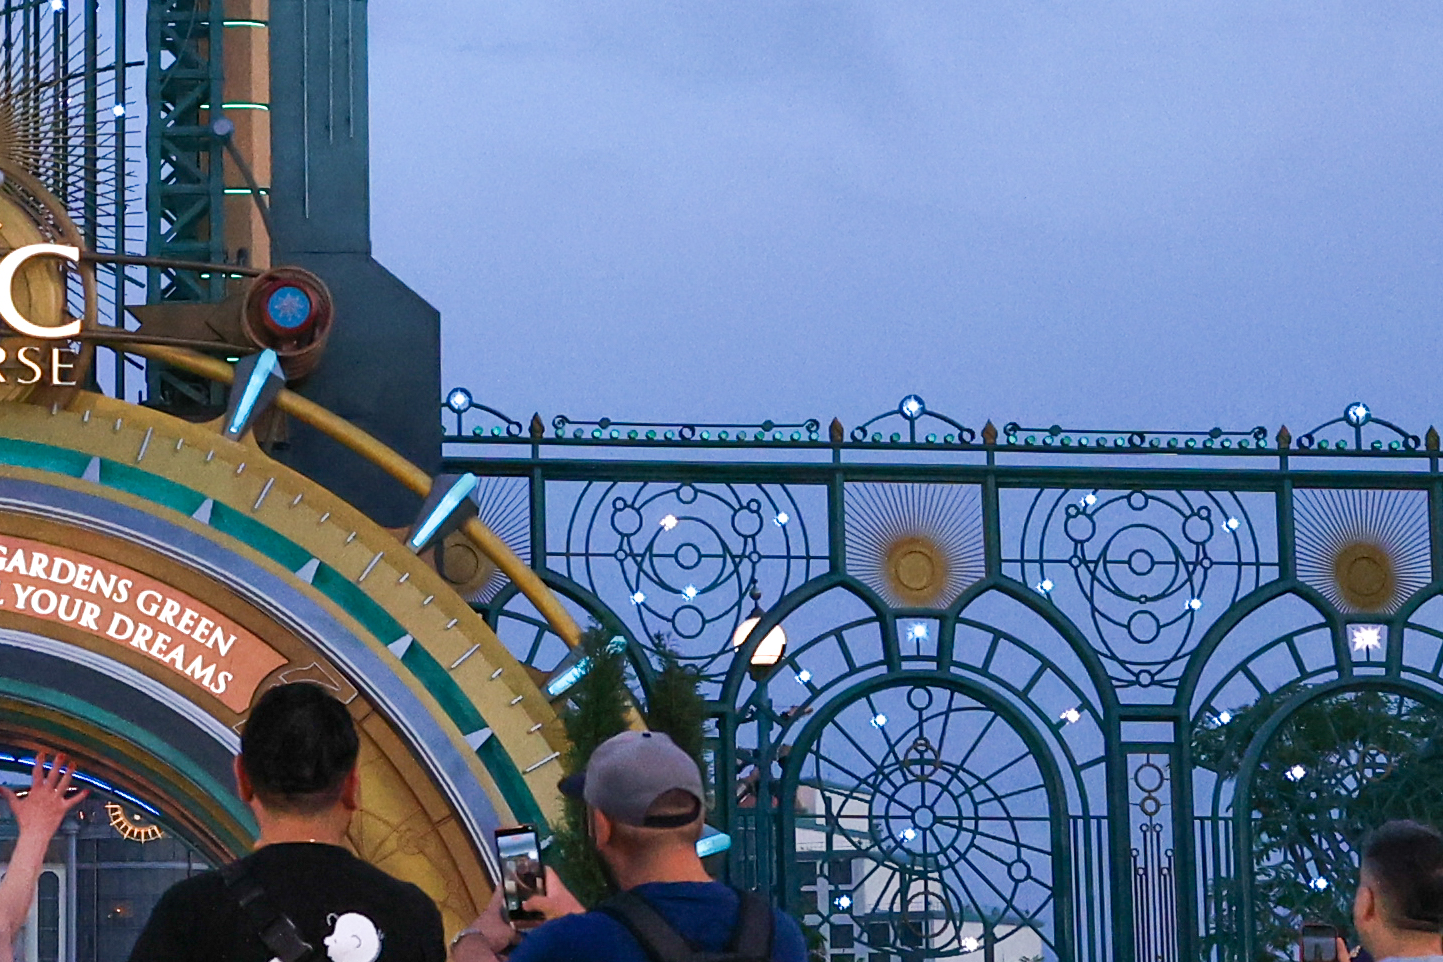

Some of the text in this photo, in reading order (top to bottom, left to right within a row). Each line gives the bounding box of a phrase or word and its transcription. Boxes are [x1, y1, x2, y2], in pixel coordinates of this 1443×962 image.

[12, 583, 100, 631] YOUR
[105, 612, 234, 695] DREAMS
[136, 589, 238, 657] GREEN
